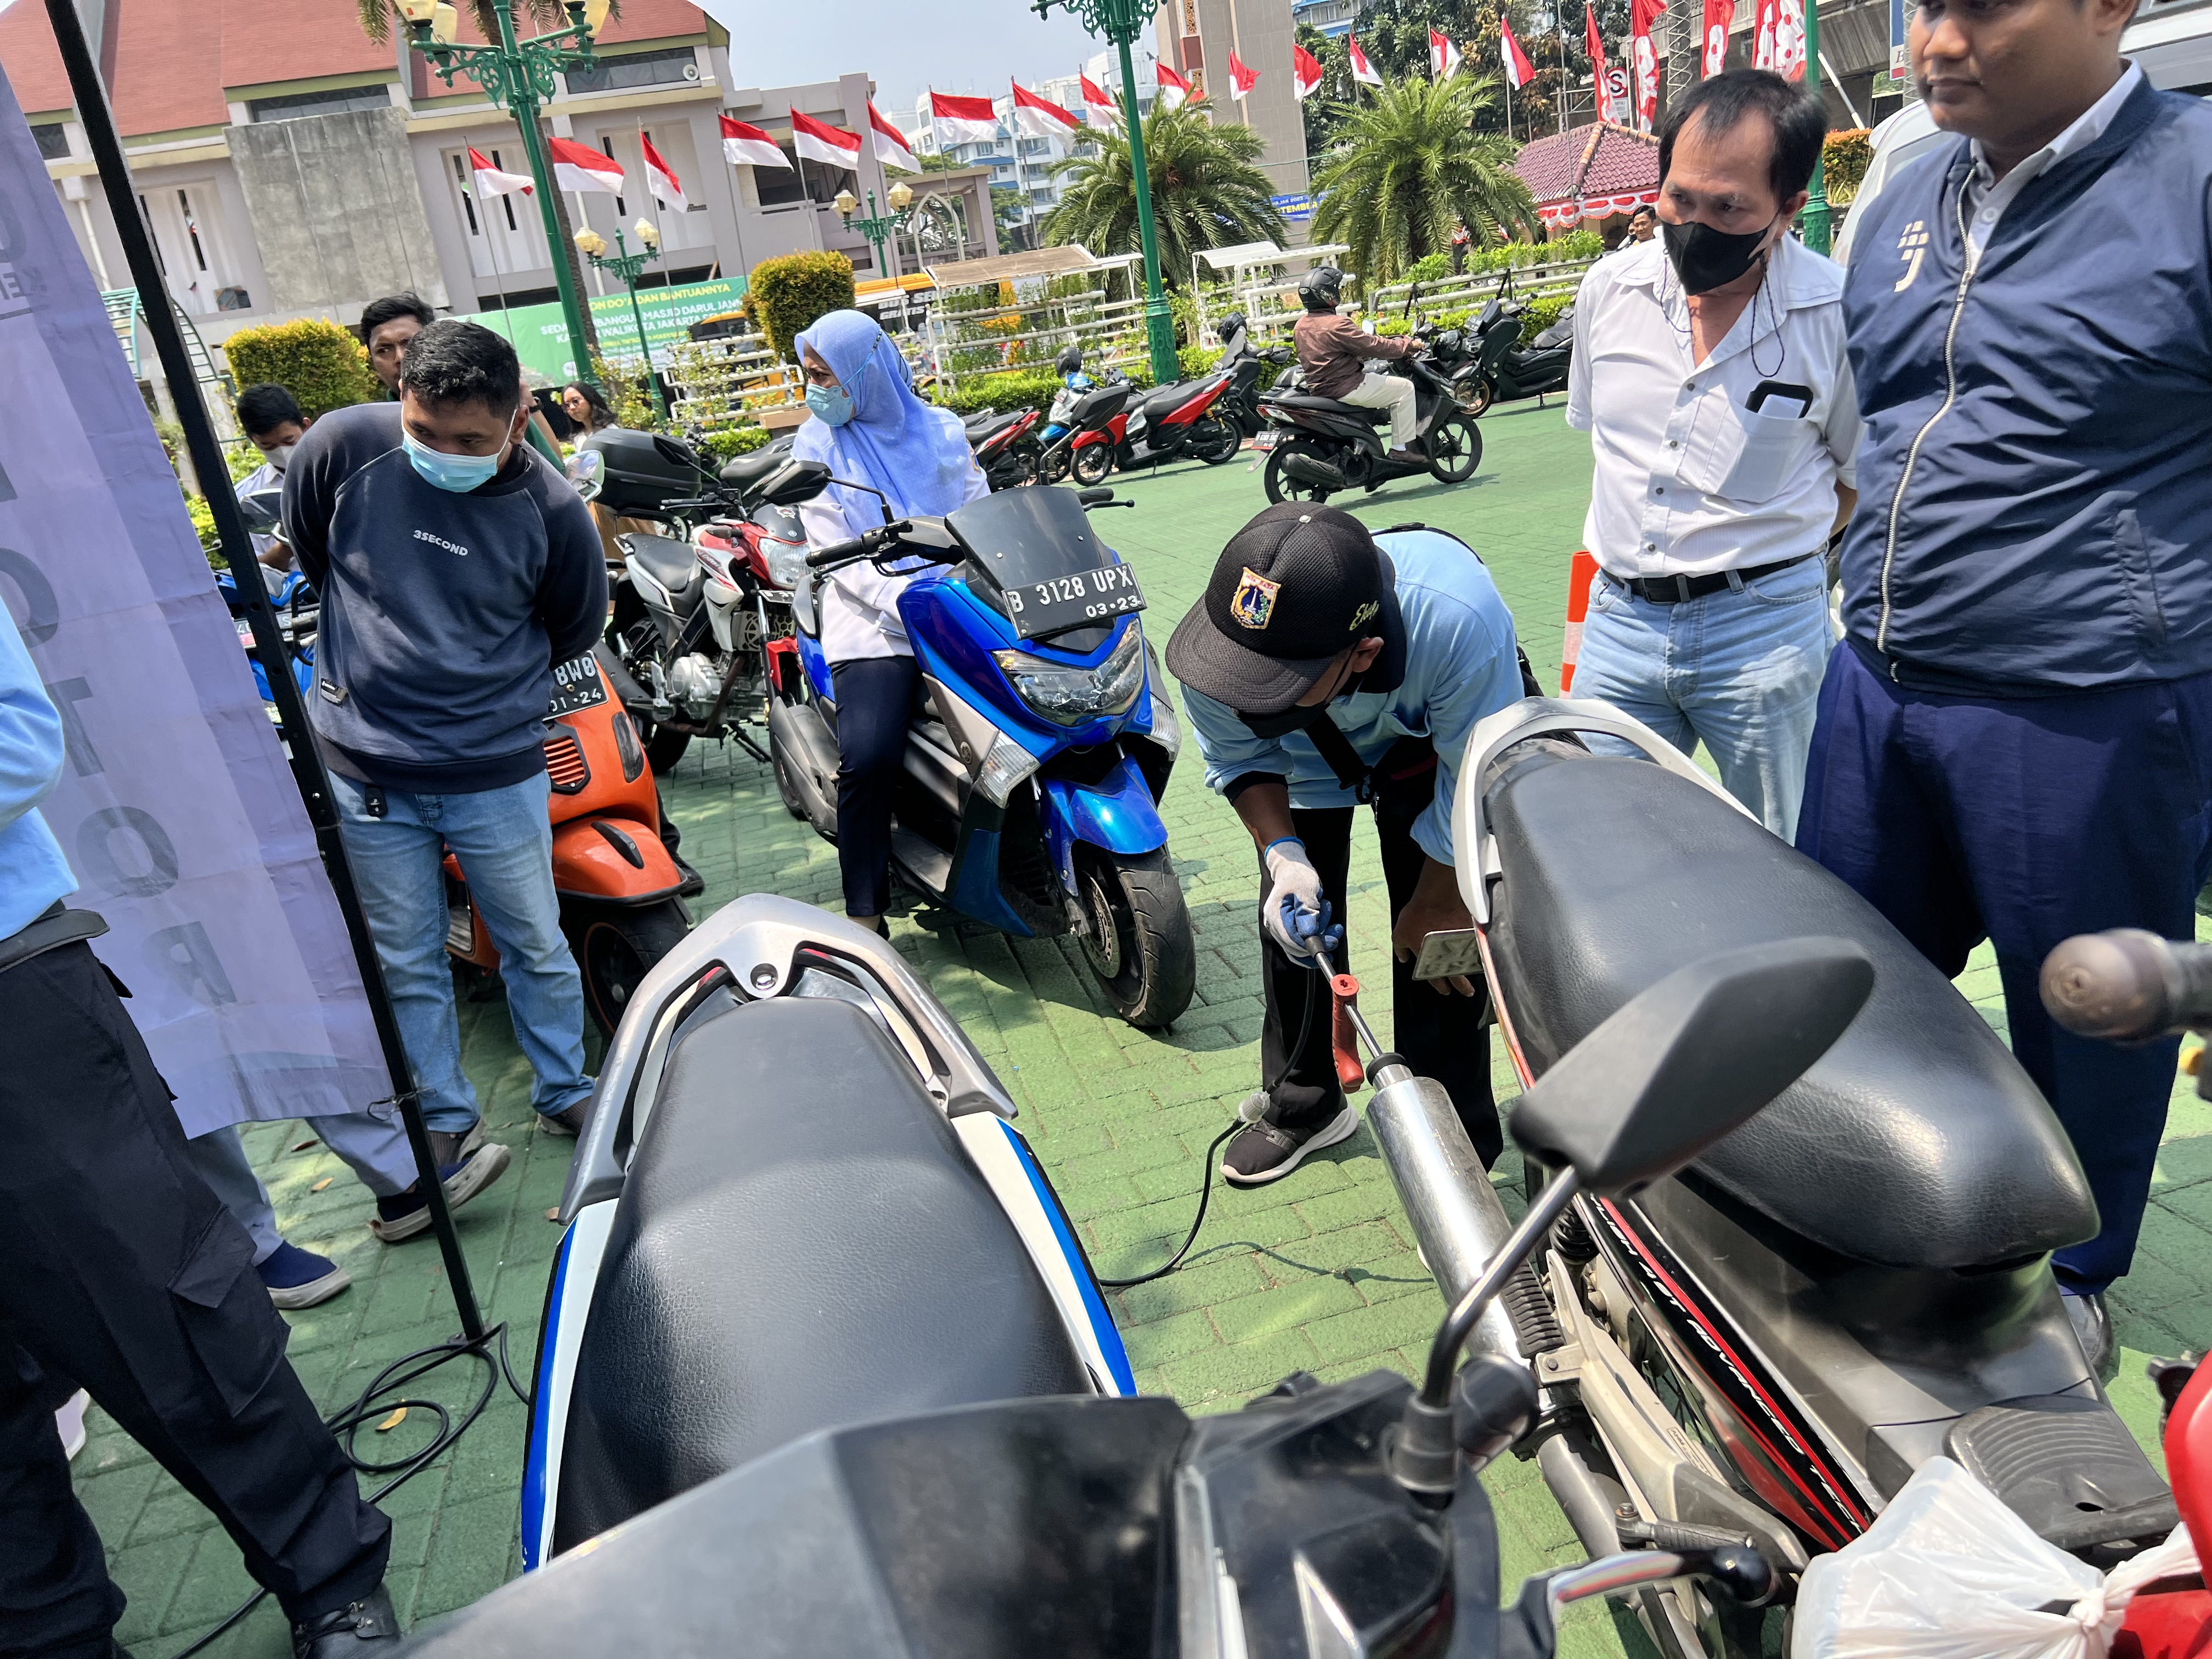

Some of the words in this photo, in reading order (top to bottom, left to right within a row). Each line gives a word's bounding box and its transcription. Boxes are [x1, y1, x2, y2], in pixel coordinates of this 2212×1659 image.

[1275, 202, 1318, 214] PTEMBER
[637, 294, 658, 304] DAN
[661, 283, 731, 301] BANTUANNYA
[540, 323, 568, 335] SEDA
[642, 307, 680, 322] MASJID
[684, 302, 716, 317] DARUL
[657, 314, 701, 329] JAKARTA
[413, 529, 469, 556] 3SECOND
[1007, 591, 1025, 613] B
[1035, 576, 1086, 606] 3128
[1092, 566, 1133, 592] UPX
[1686, 1319, 1805, 1455] ADVANCED
